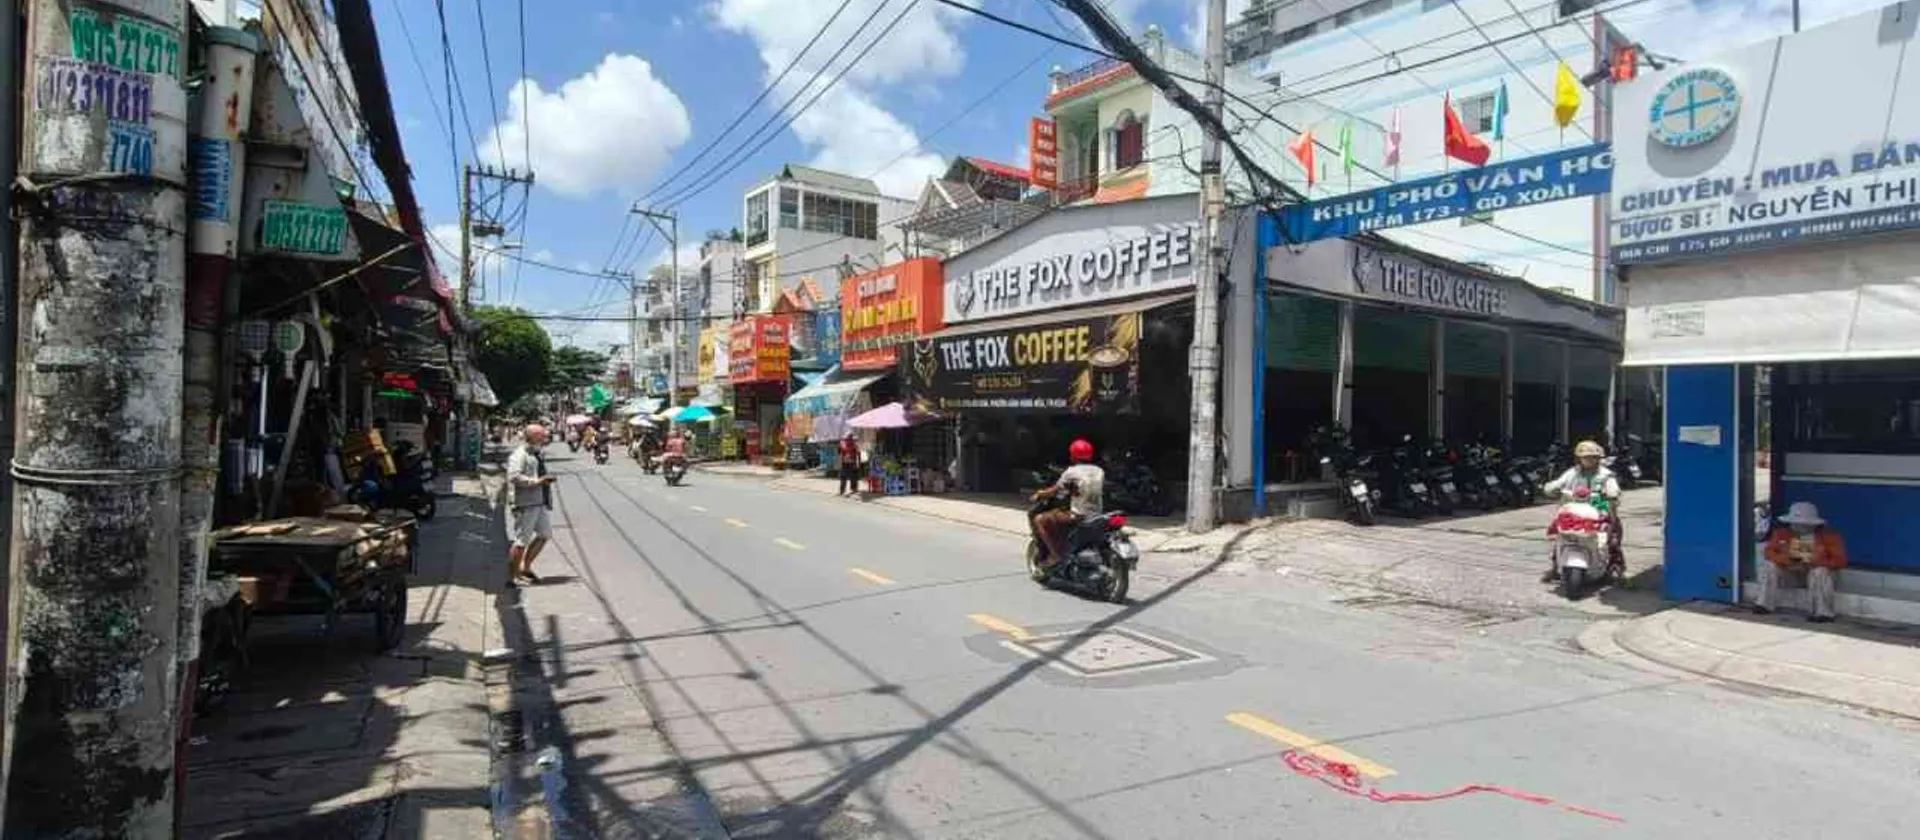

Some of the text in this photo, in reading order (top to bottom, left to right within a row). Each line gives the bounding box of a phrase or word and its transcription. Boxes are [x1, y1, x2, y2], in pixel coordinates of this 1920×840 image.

[1313, 197, 1375, 222] KHU
[1387, 174, 1458, 208] PHỐ
[1413, 204, 1450, 221] 173
[1476, 192, 1508, 212] GÒ
[1620, 177, 1734, 213] CHUYÊN
[1761, 159, 1840, 188] MUA
[1728, 186, 1852, 223] NGUYỄN
[1863, 178, 1916, 203] THỊ
[981, 226, 1192, 301] THE FOX COFFEE
[1380, 257, 1510, 316] THE FOX COFFEE
[940, 341, 974, 371] THE
[976, 336, 1011, 368] FOX
[1014, 325, 1092, 366] COFFEE
